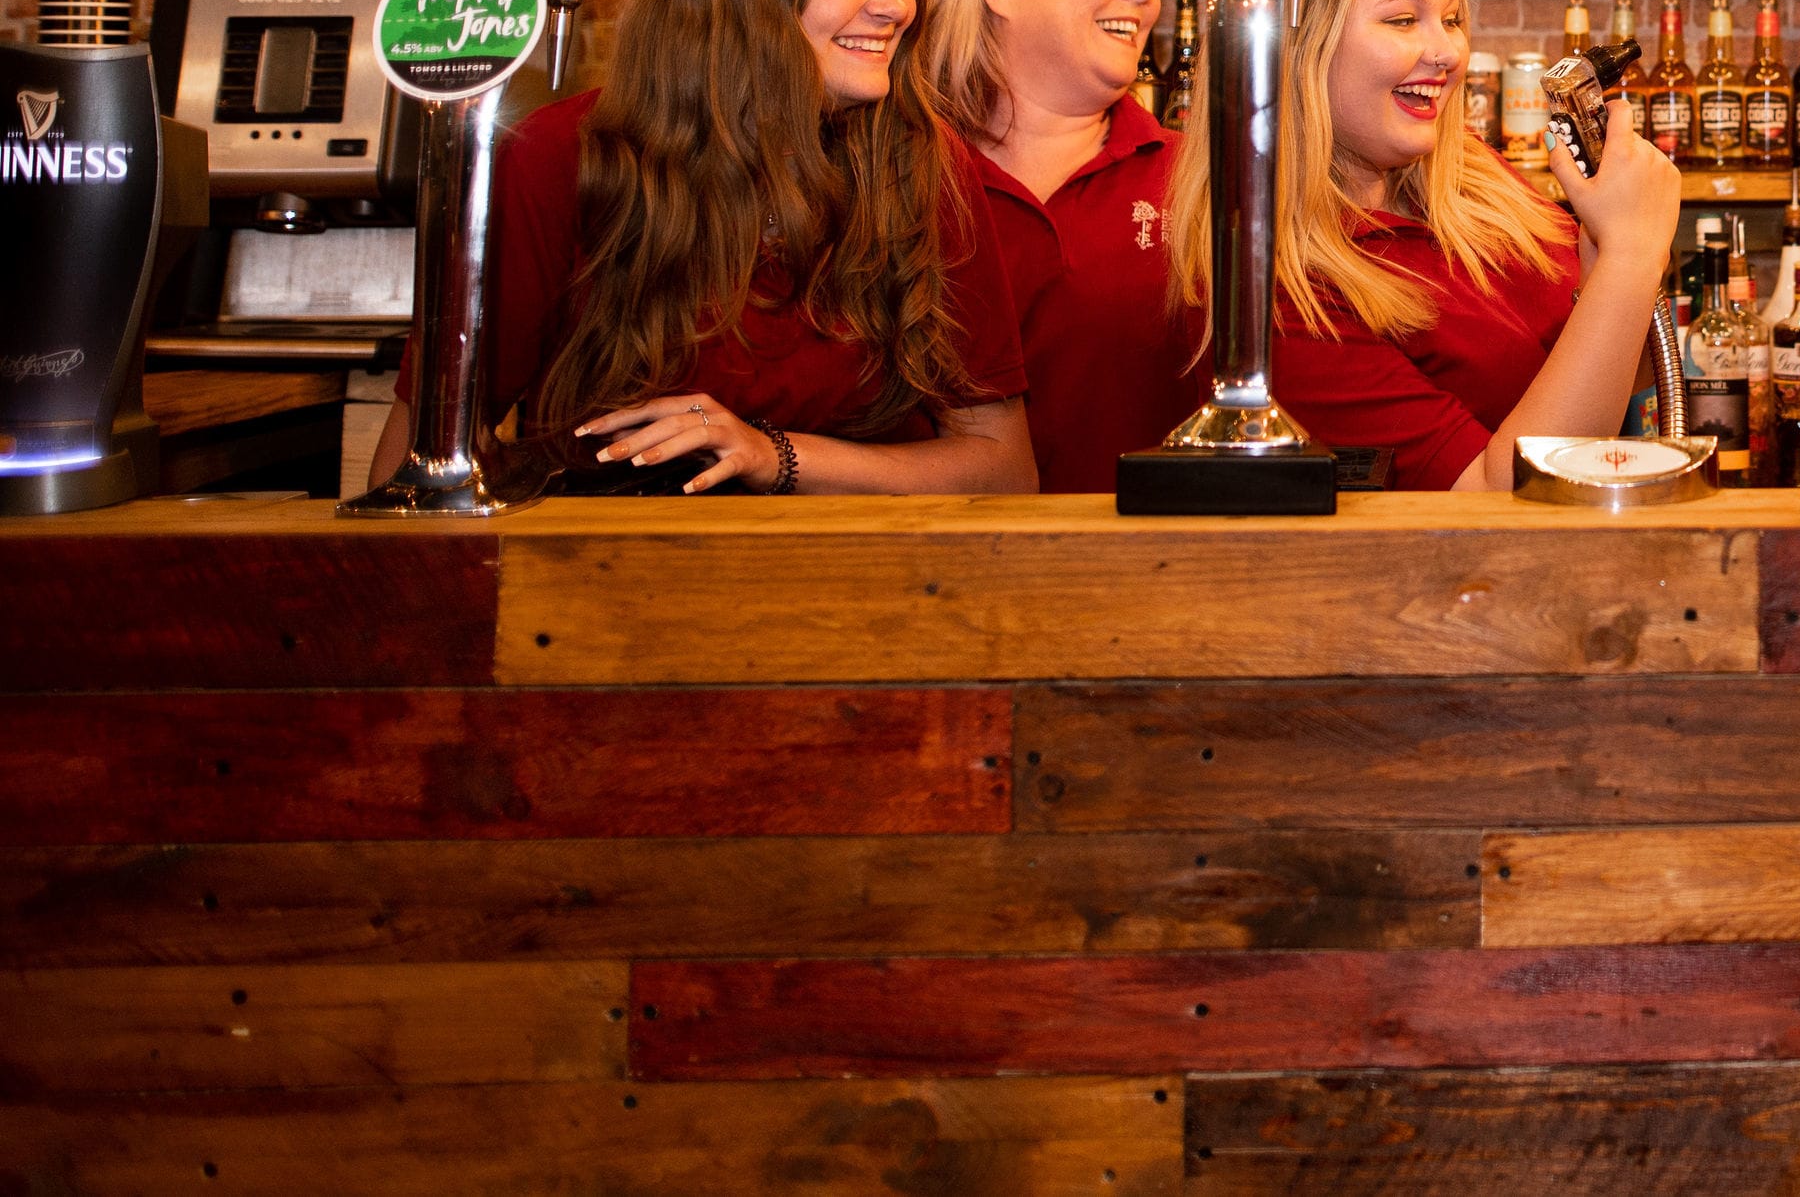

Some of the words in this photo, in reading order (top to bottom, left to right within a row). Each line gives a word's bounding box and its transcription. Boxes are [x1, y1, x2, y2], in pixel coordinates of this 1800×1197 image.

[447, 7, 531, 52] Jones
[391, 42, 423, 55] 4.5%
[424, 45, 443, 54] ABV
[410, 65, 442, 73] TOMOS
[452, 64, 492, 73] LILFORD
[0, 146, 128, 179] INNESS
